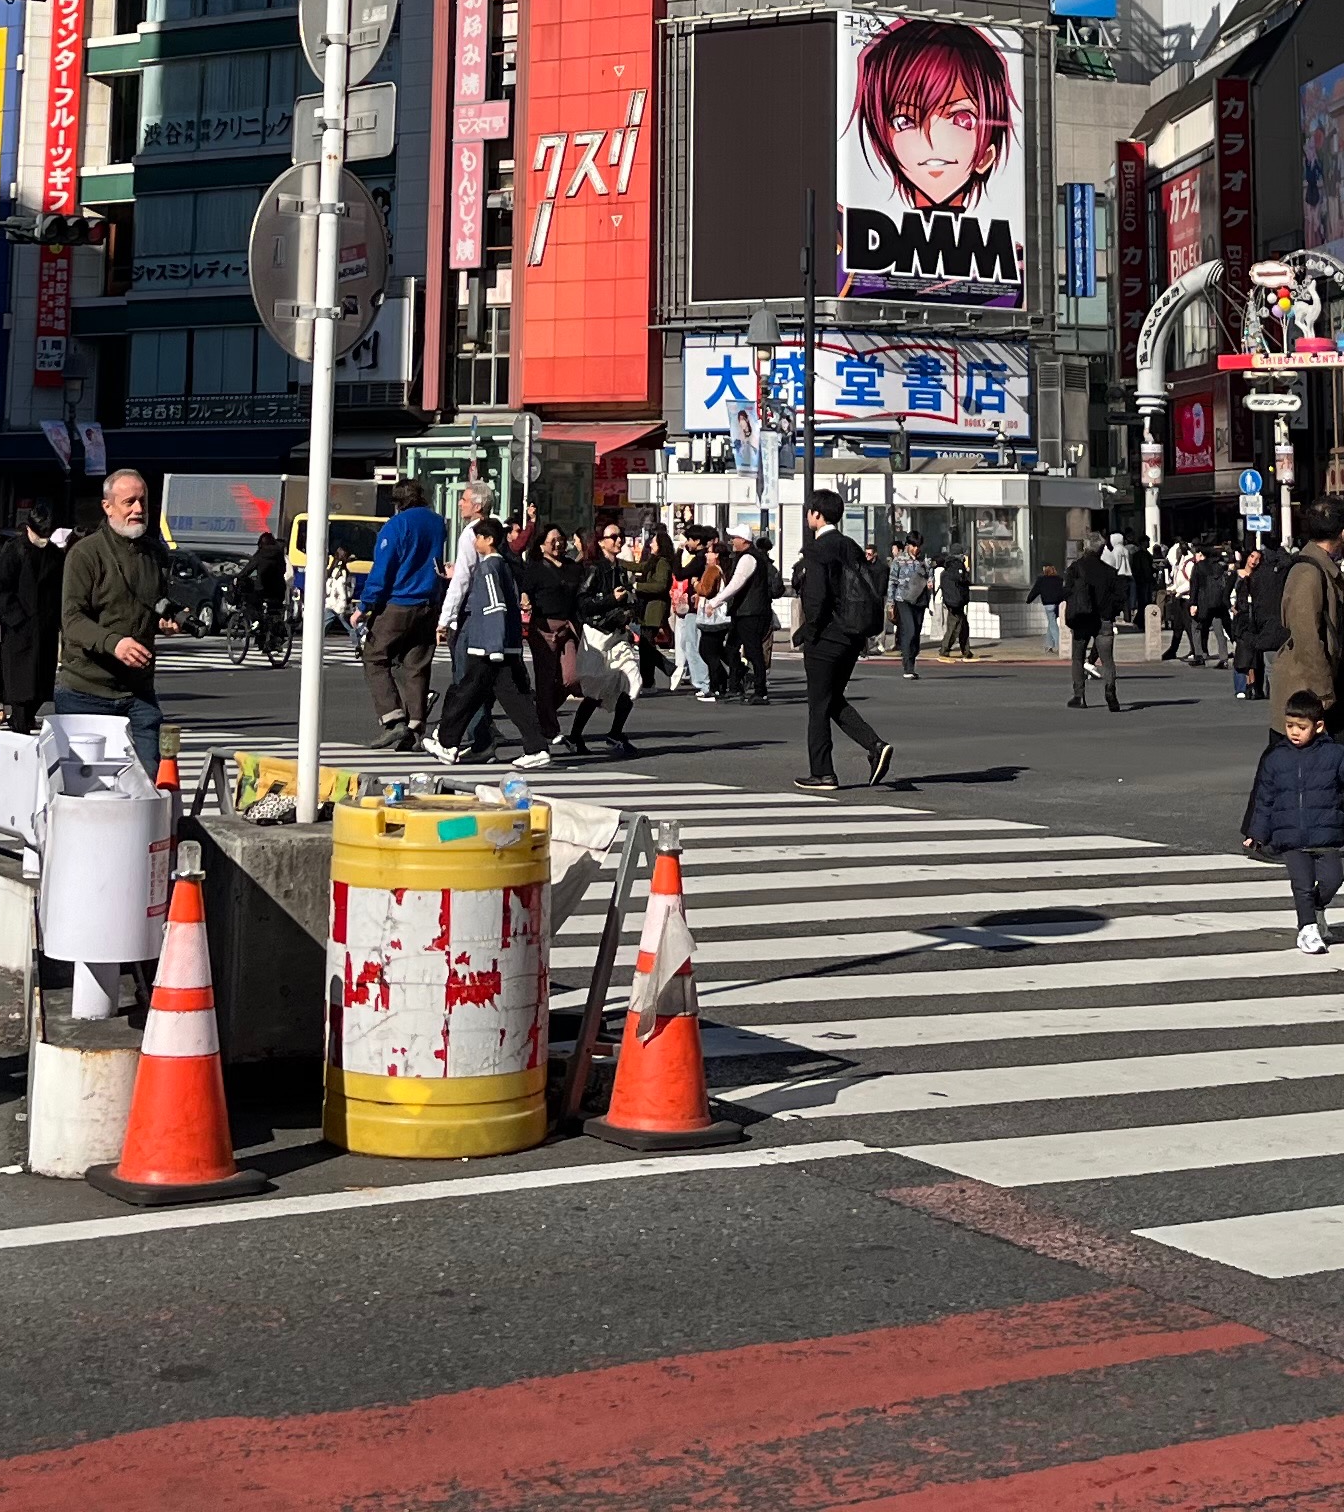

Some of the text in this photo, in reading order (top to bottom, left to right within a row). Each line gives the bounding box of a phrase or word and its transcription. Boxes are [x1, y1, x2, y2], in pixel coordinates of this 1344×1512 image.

[1122, 160, 1136, 232] BIGECHO
[1221, 96, 1248, 230] カラオケ
[455, 147, 477, 264] もんじゃ焼
[844, 207, 1021, 284] DMM
[704, 350, 1009, 416] 大盛堂書店
